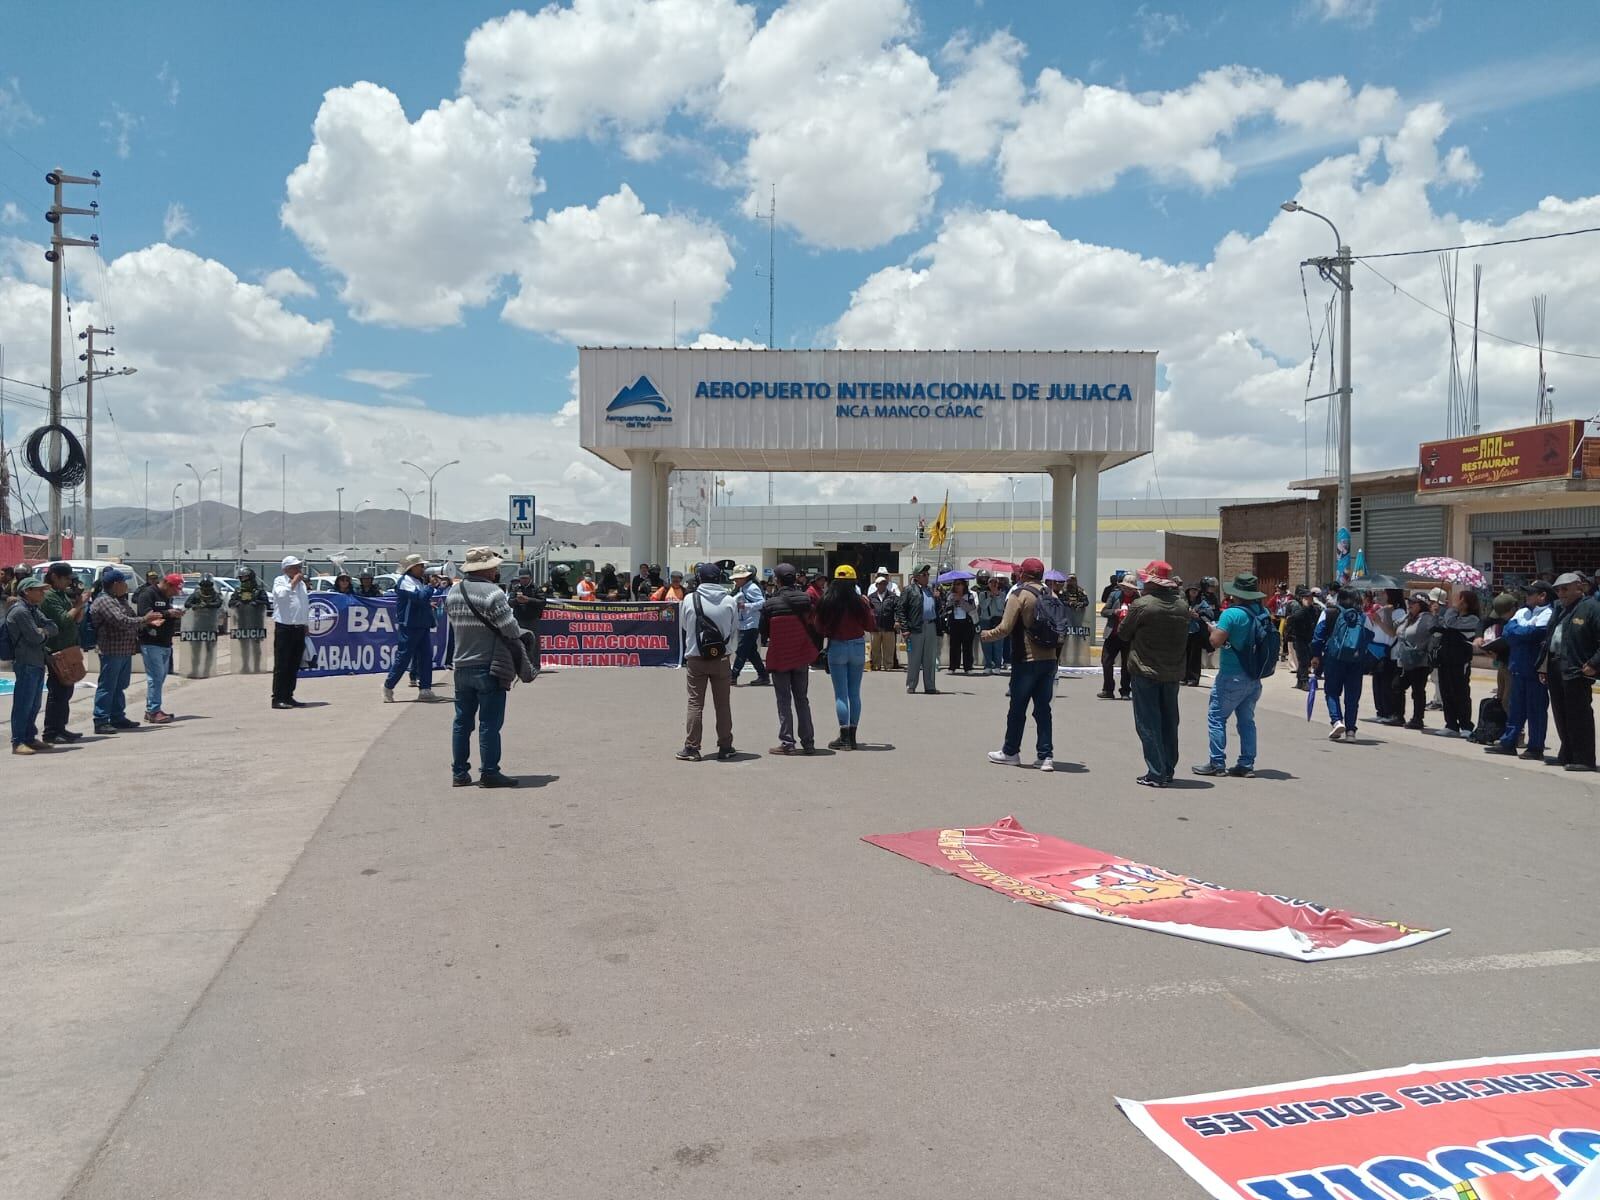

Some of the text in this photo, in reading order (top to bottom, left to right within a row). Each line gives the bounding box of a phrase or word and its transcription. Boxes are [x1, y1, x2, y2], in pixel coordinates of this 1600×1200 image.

[695, 381, 1132, 401] AEROPUERTO INTERNACIONAL DE JULIACA
[836, 402, 983, 418] INCA MANCO CÁPAC
[1462, 456, 1520, 472] RESTAURANT
[513, 499, 531, 520] T
[347, 606, 400, 632] BA
[541, 609, 659, 620] DICATO DE DOCENTES
[231, 629, 265, 639] POLICIA
[569, 622, 613, 632] SIDUNA
[1067, 626, 1088, 635] OLICIA
[181, 631, 216, 640] POLICIA
[582, 635, 669, 649] NACIONAL
[316, 645, 374, 670] ABAJO
[541, 653, 640, 666] INDEFINIDA
[1398, 1070, 1592, 1106] CIENCIAS
[1183, 1092, 1403, 1137] SOCIALES
